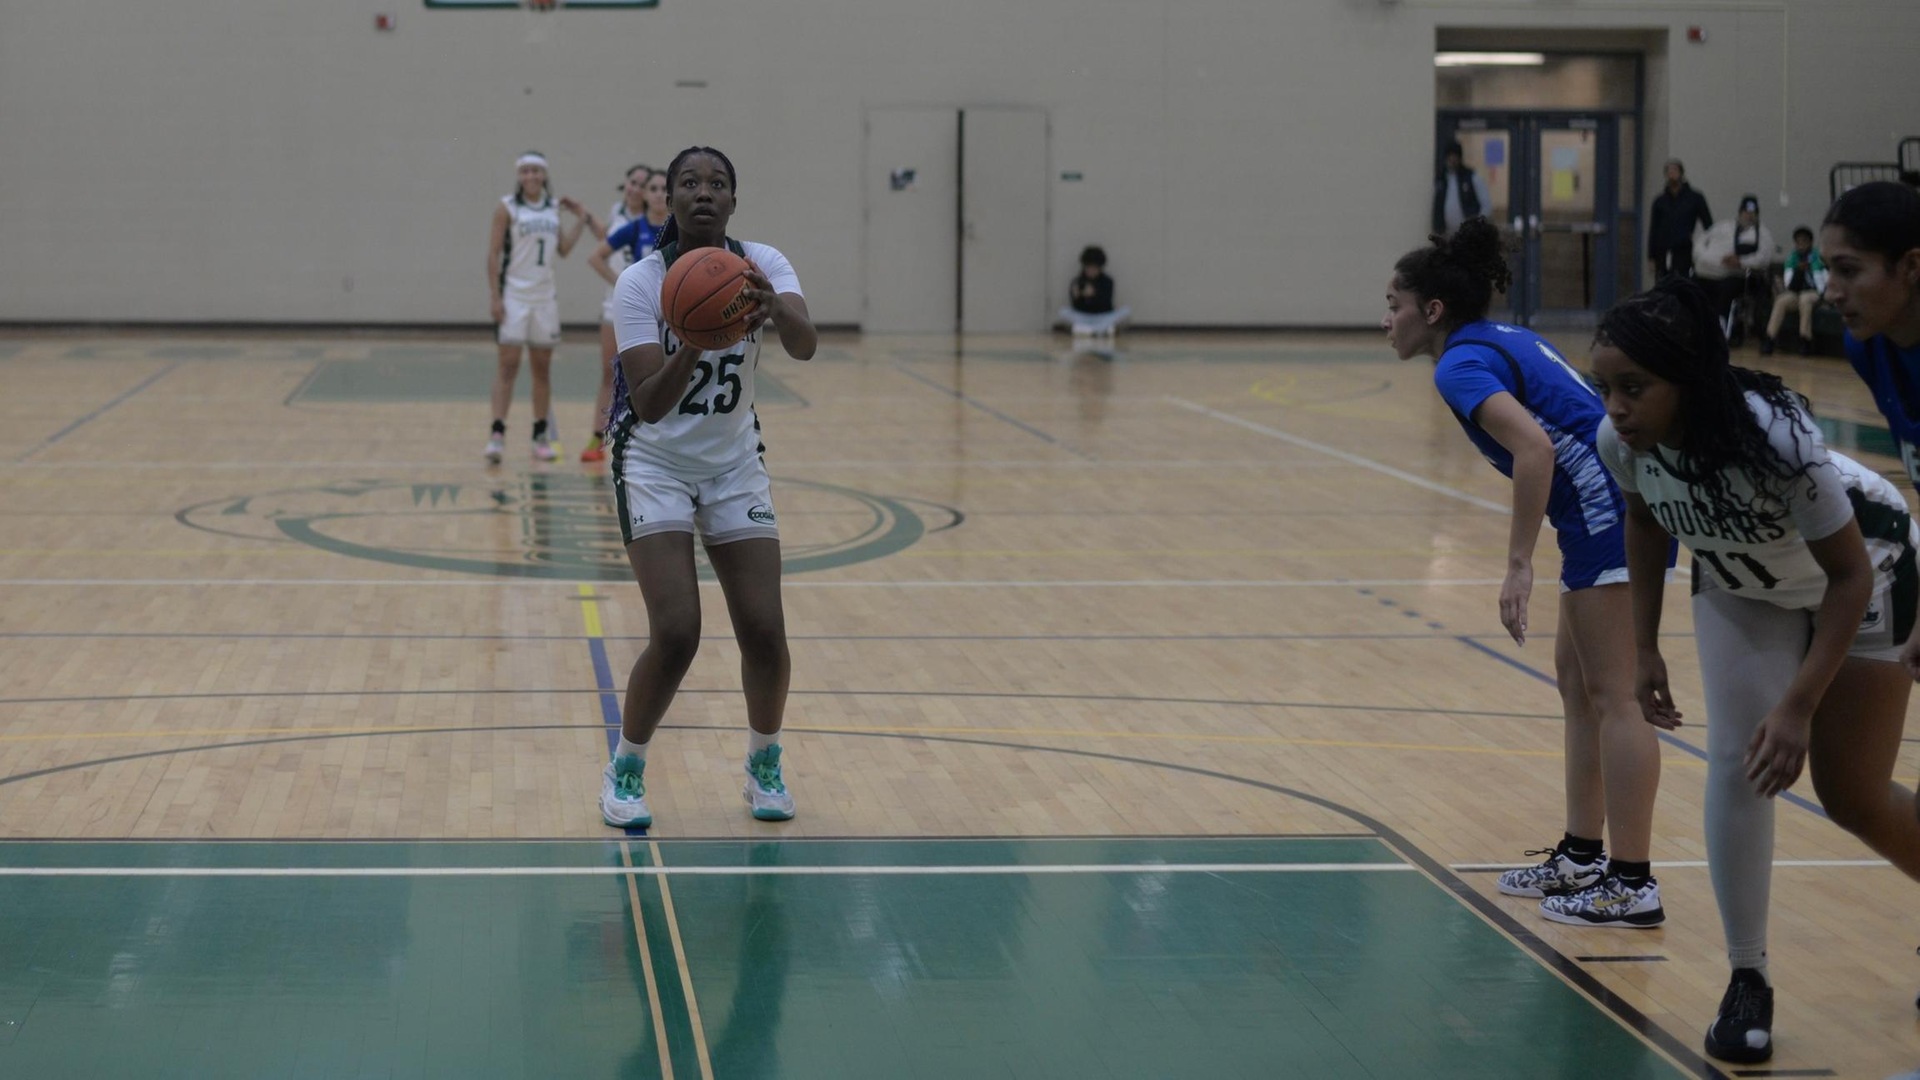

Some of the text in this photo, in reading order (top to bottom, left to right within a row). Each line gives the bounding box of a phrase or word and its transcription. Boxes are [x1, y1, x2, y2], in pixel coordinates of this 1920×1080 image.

[536, 237, 546, 266] 1
[679, 354, 746, 416] 25
[1694, 548, 1781, 590] 11
